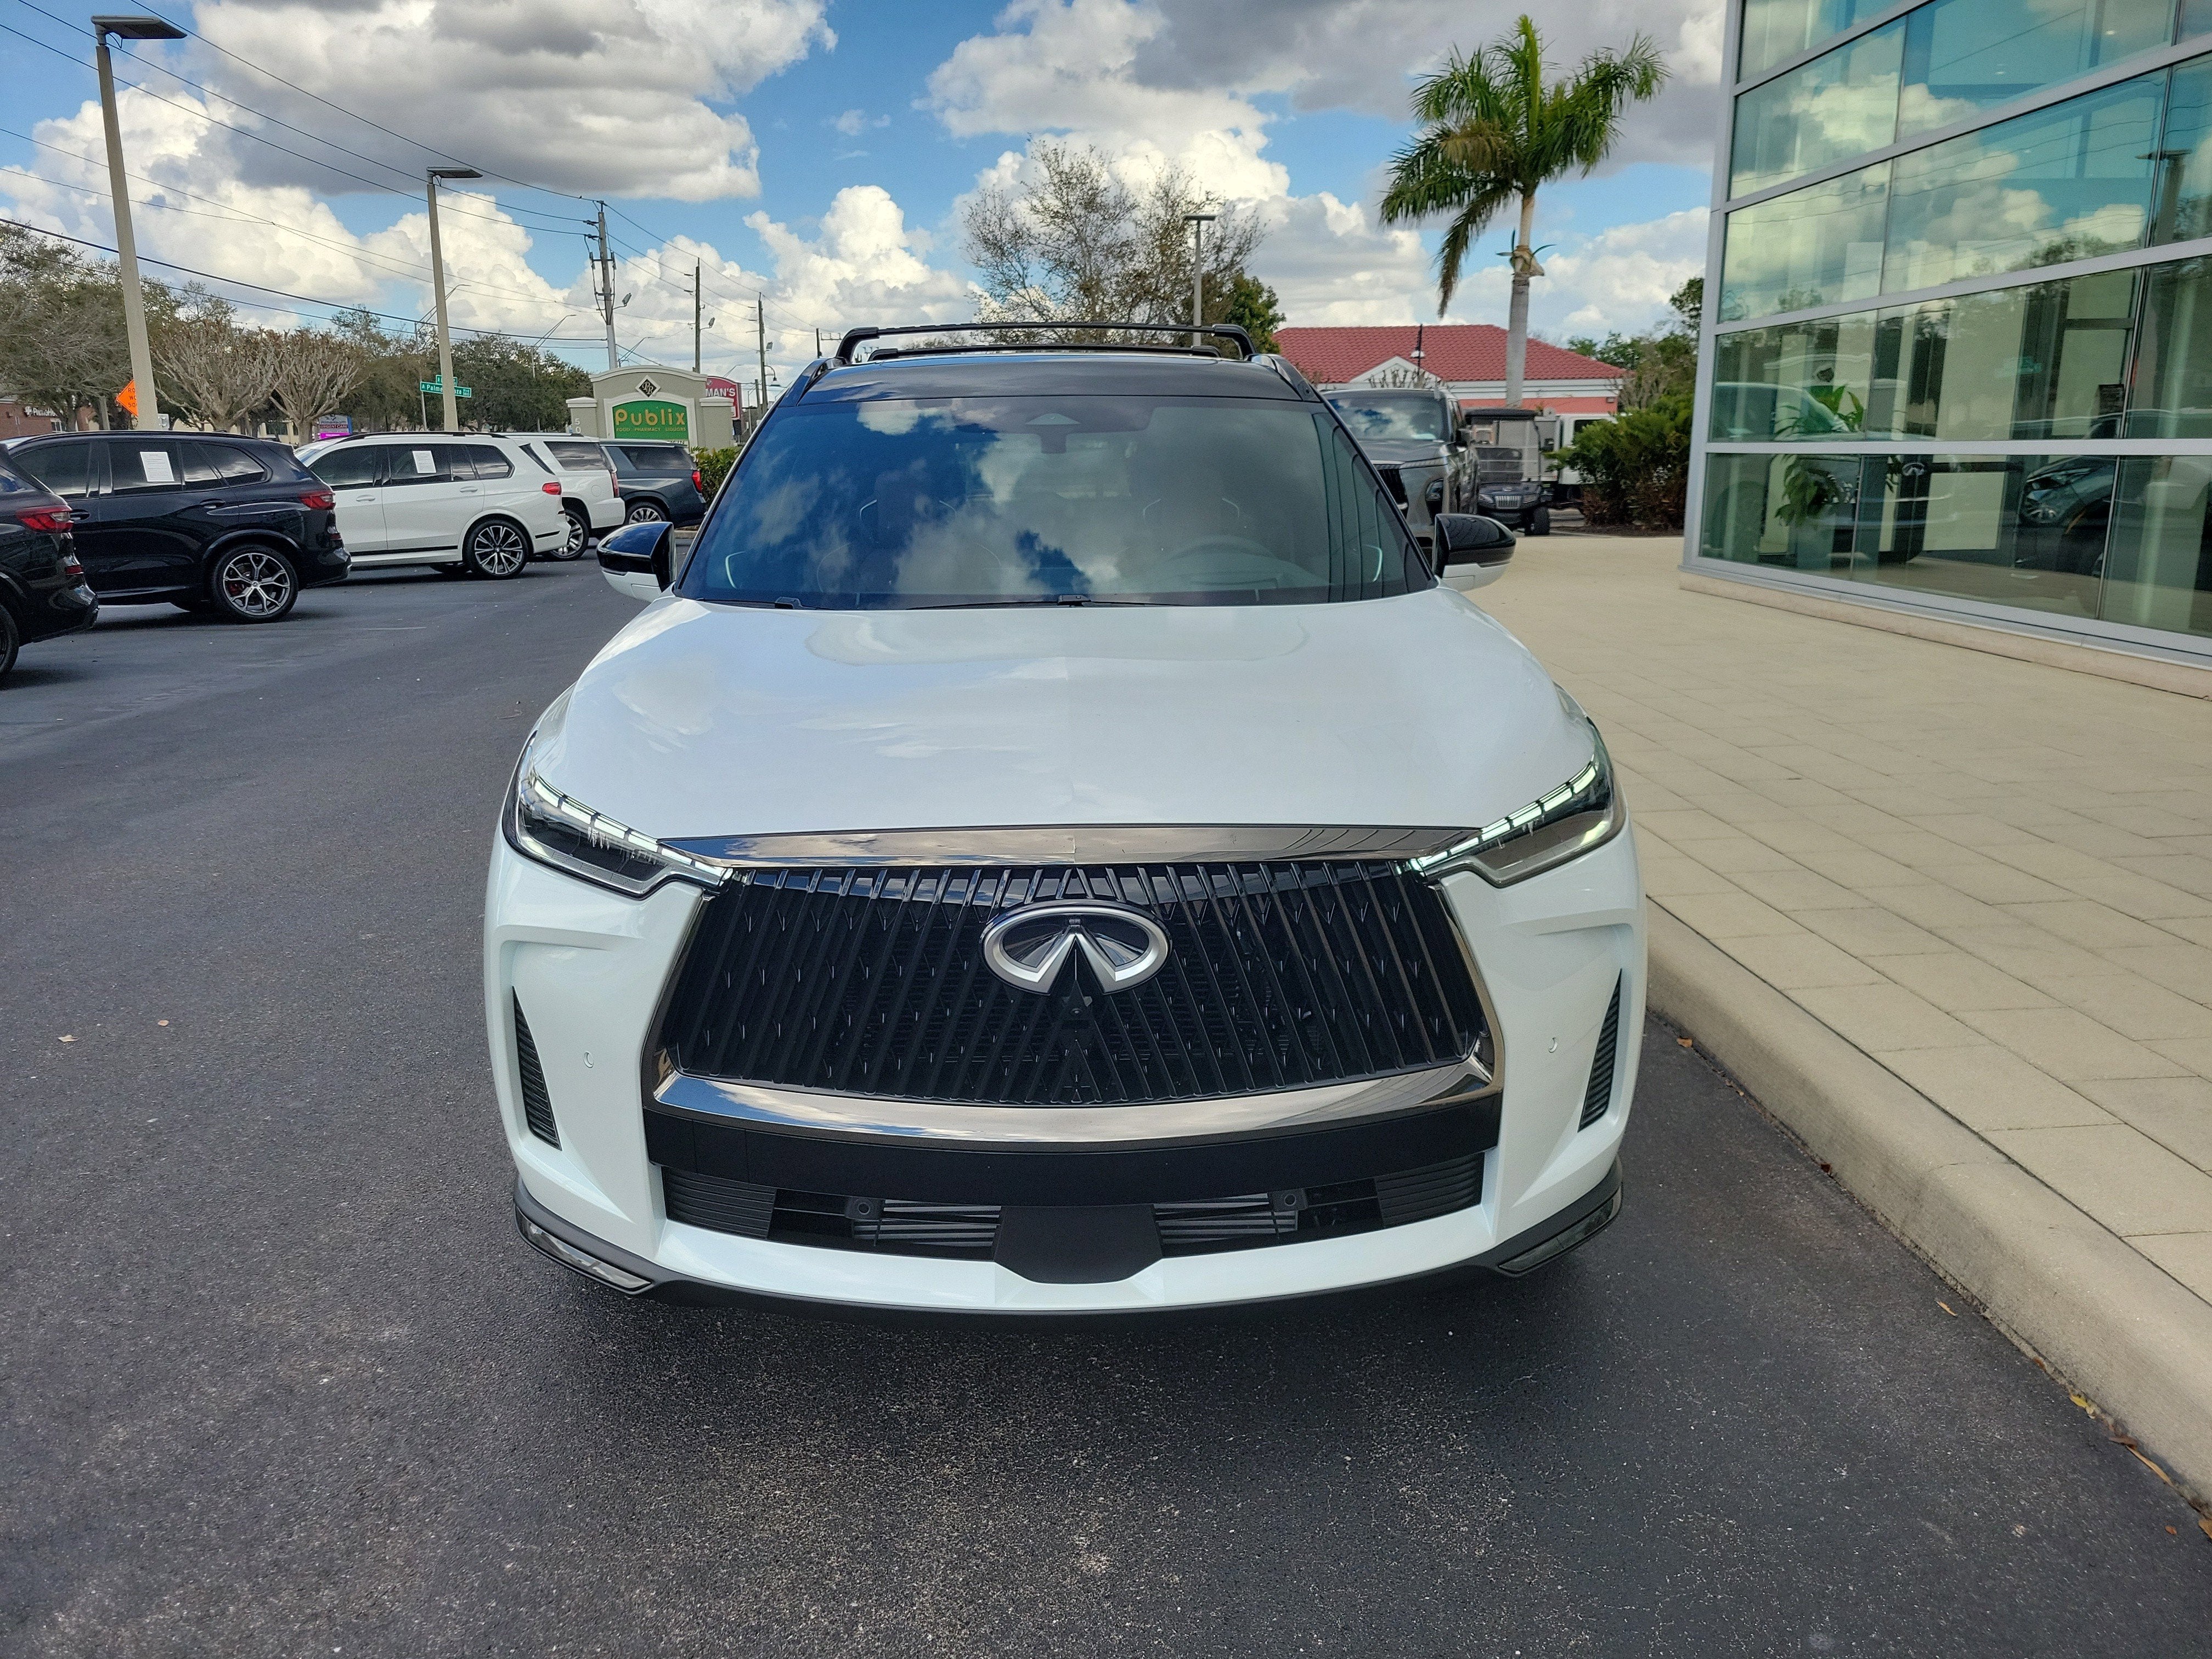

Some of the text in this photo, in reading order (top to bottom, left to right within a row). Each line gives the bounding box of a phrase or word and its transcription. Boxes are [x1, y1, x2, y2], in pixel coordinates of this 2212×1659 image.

[426, 384, 443, 392] Palme
[706, 387, 736, 397] MAN'S
[615, 409, 685, 426] Publix
